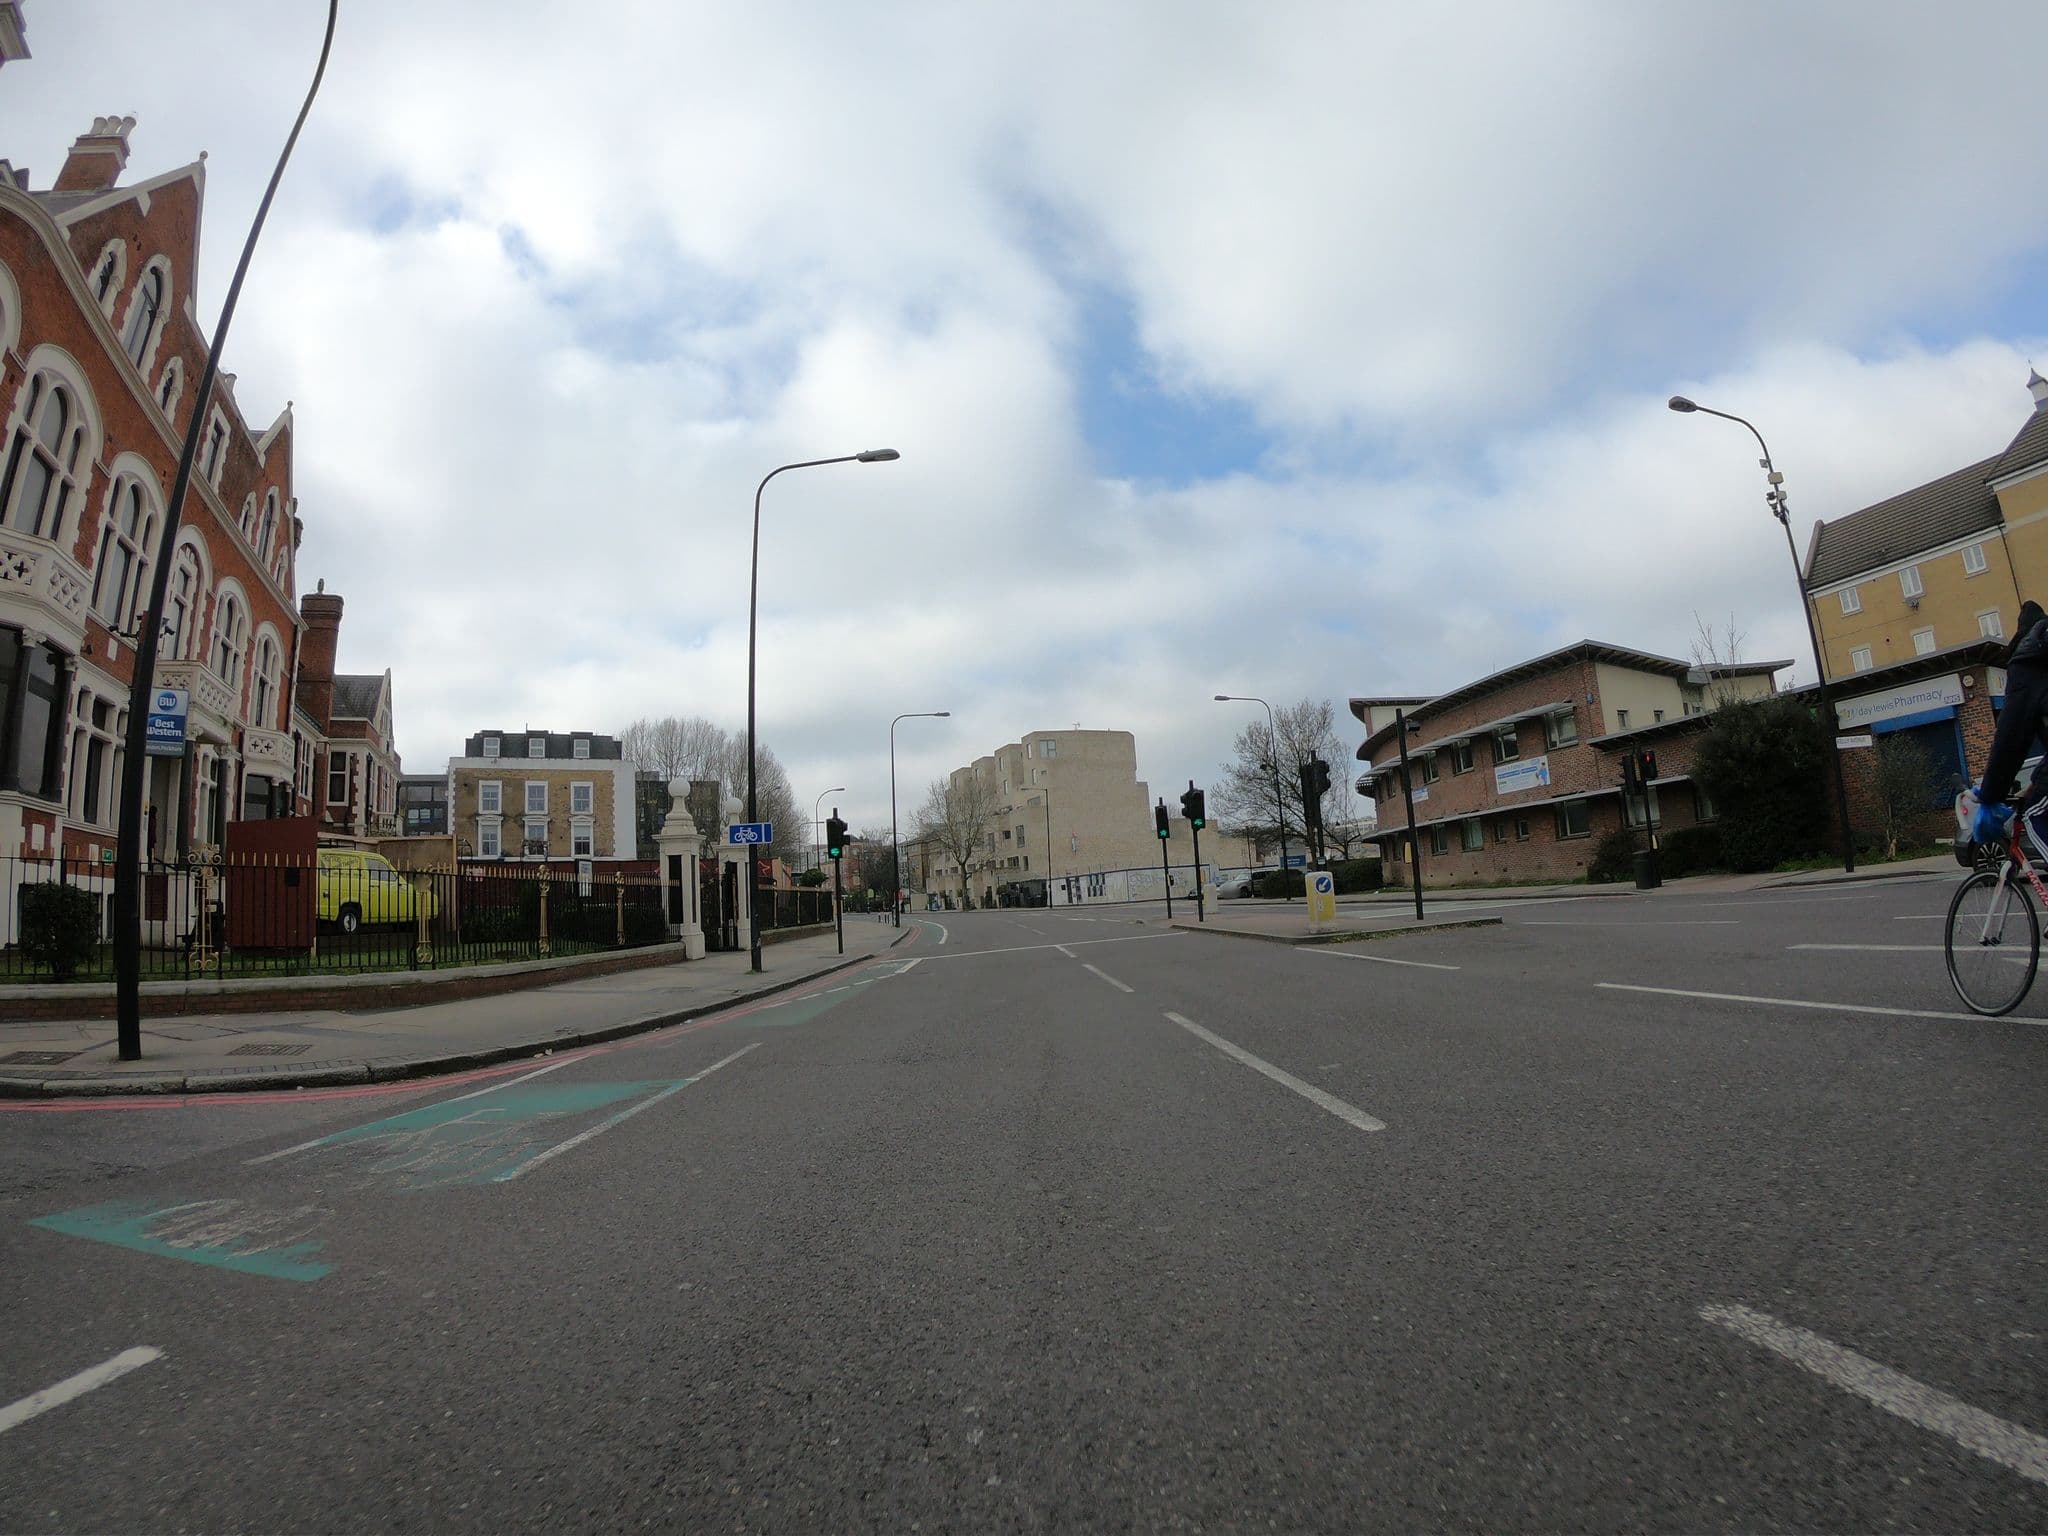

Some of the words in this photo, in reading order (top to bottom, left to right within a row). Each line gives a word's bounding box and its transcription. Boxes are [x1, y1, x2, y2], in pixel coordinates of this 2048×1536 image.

[159, 697, 176, 707] BW
[1873, 702, 1894, 712] lewis
[1894, 690, 1942, 708] Pharmacy
[155, 719, 175, 728] Best
